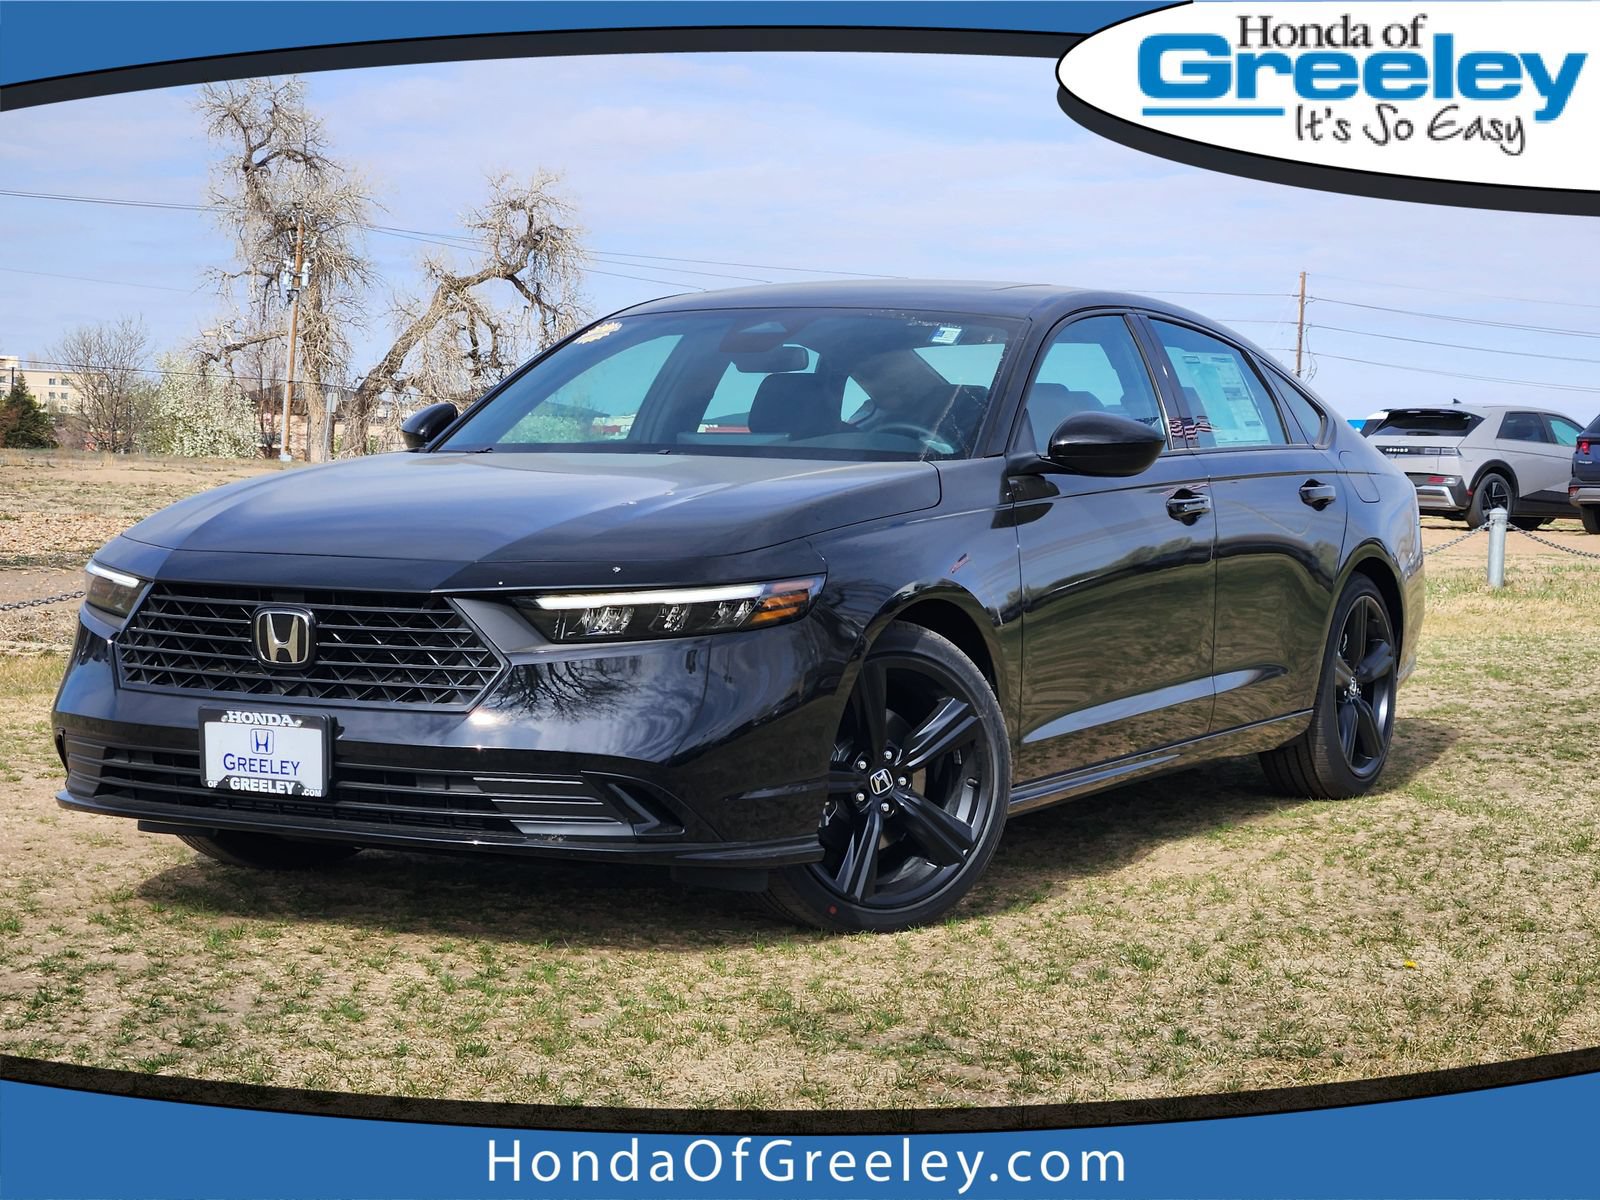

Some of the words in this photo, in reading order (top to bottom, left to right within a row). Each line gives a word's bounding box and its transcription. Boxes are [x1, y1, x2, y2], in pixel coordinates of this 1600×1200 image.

[226, 710, 300, 727] HONDA
[223, 753, 300, 776] GREELEY
[207, 780, 219, 788] OF
[229, 777, 296, 795] GREELEY
